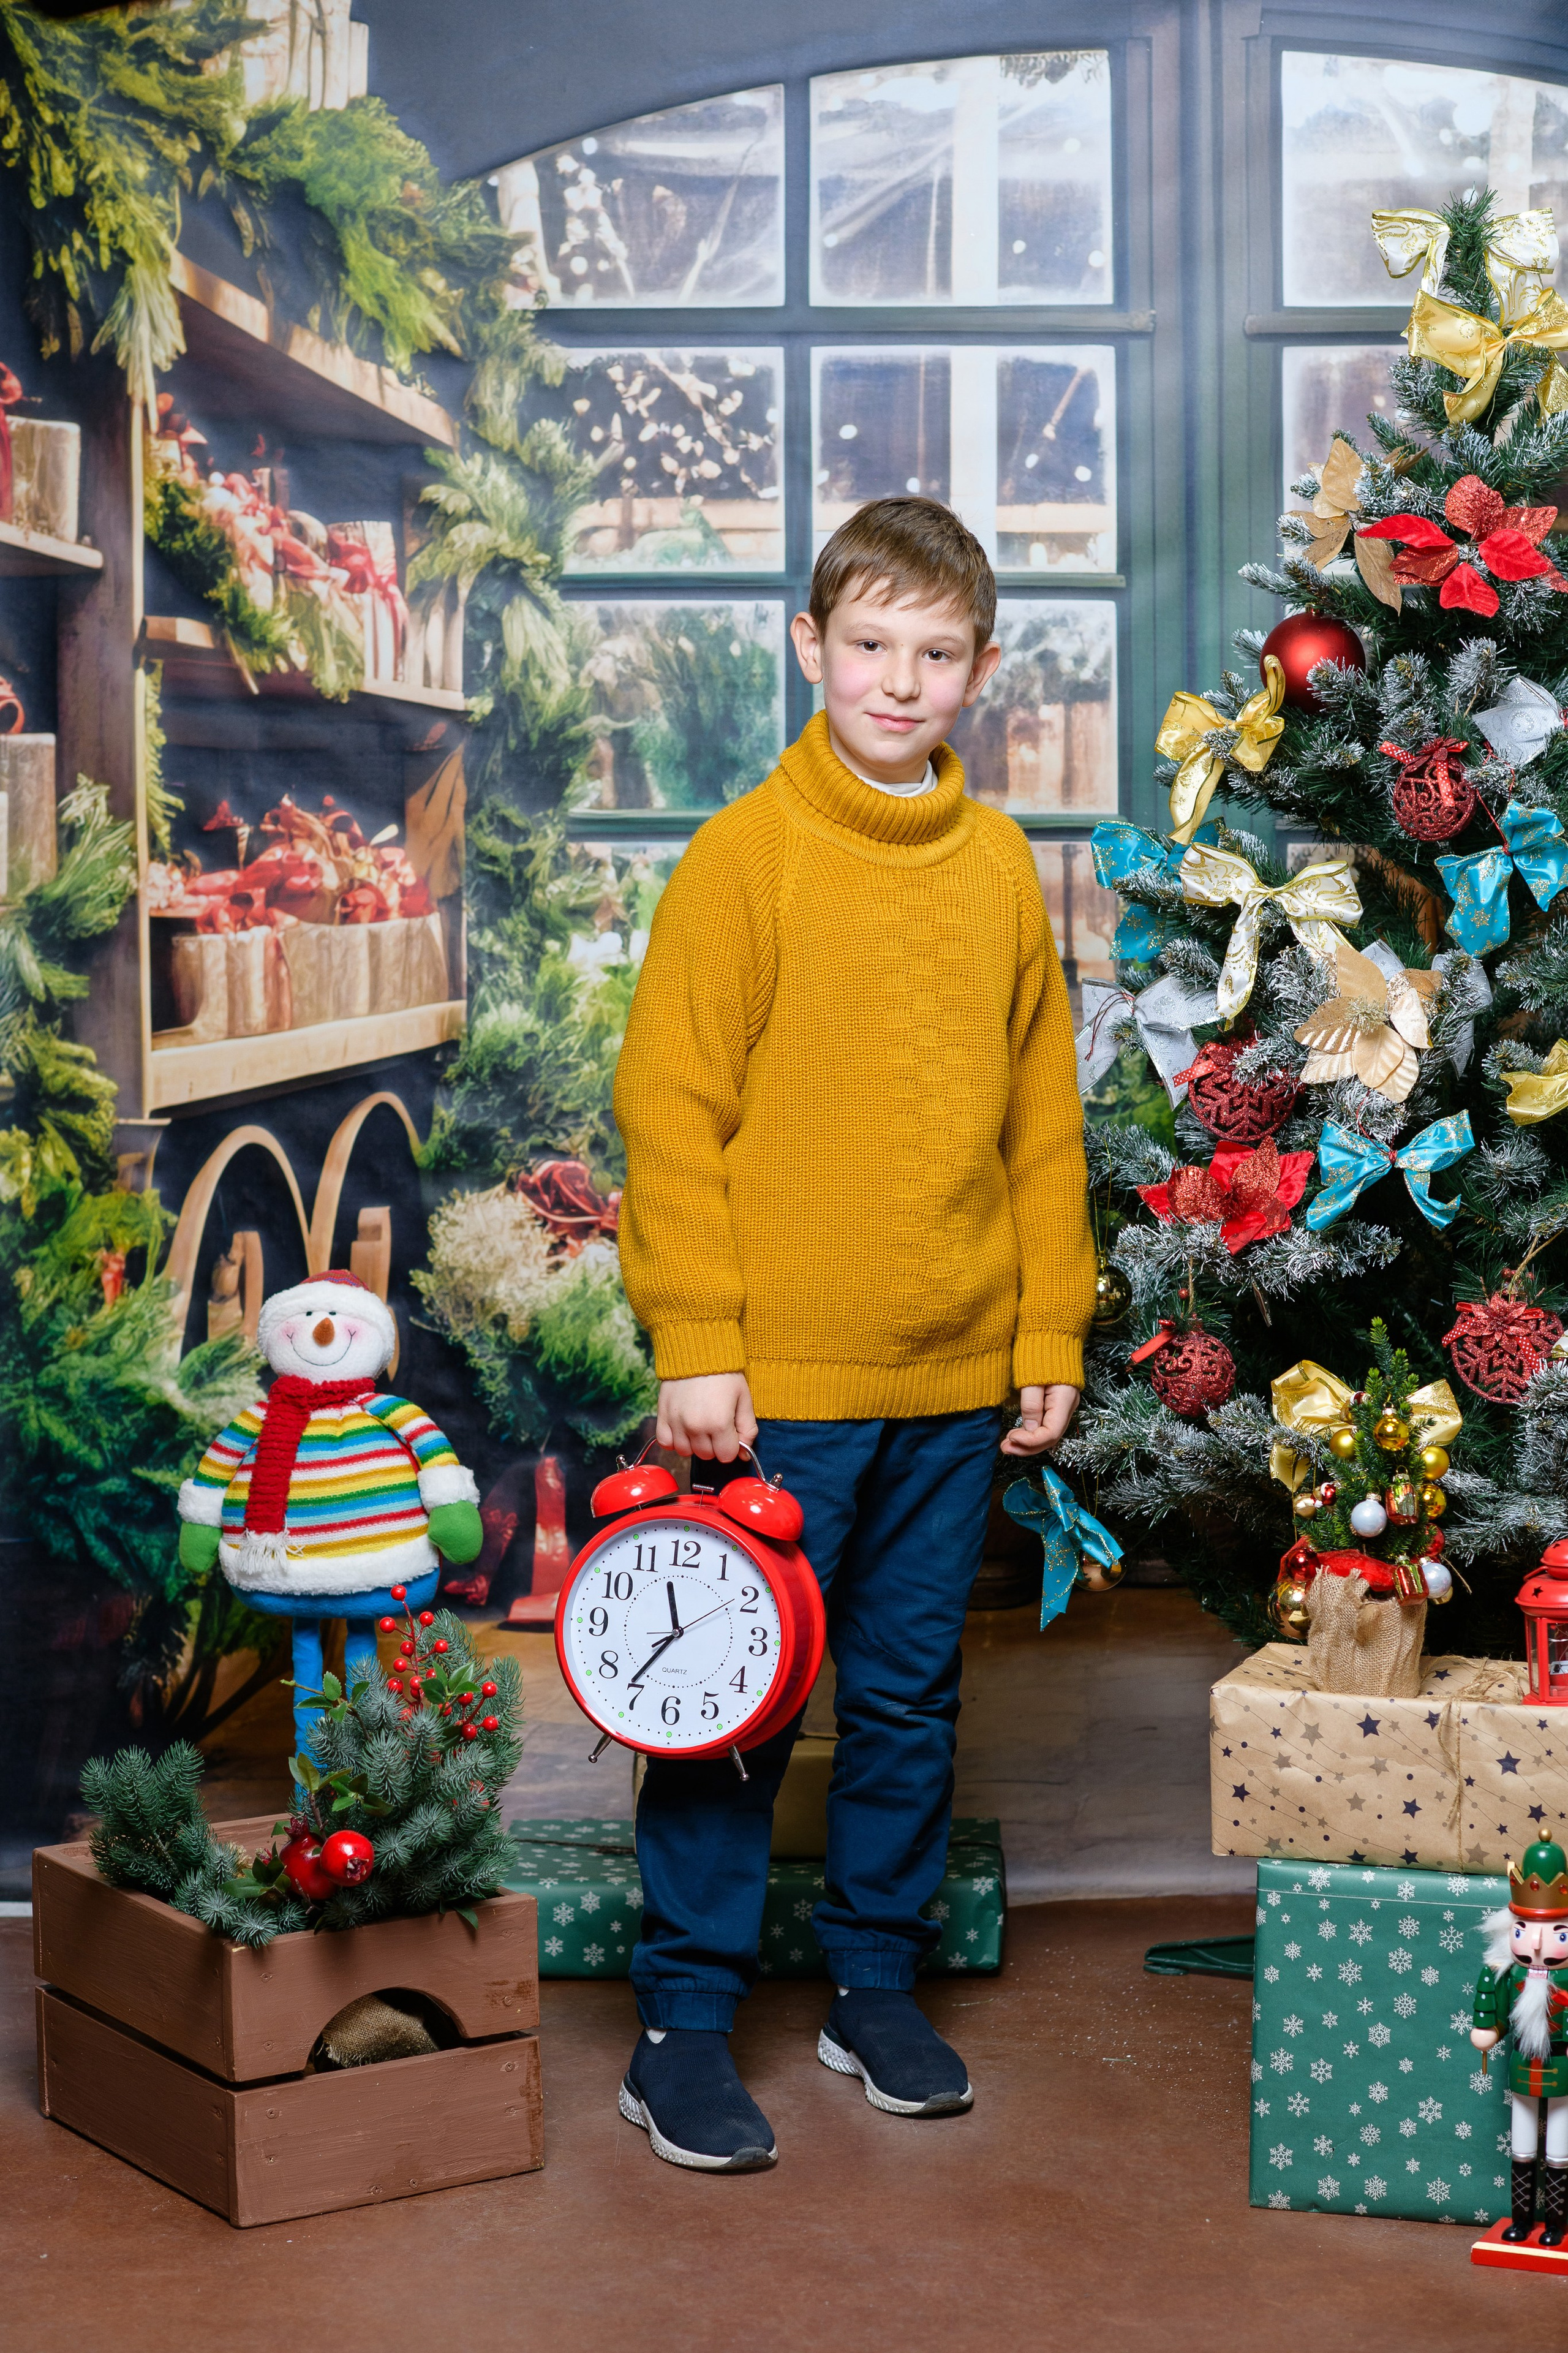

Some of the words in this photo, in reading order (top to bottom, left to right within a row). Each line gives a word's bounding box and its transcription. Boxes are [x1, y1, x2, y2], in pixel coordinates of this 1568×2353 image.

[633, 1544, 658, 1572] 11
[669, 1539, 701, 1568] 12
[717, 1554, 729, 1581] 1
[601, 1571, 633, 1600] 10
[740, 1586, 759, 1614] 2
[589, 1607, 608, 1636] 9
[748, 1627, 767, 1656] 3
[599, 1650, 618, 1679] 8
[729, 1666, 748, 1693] 4
[627, 1683, 644, 1710] 7
[662, 1696, 680, 1725] 6
[701, 1691, 719, 1720] 5
